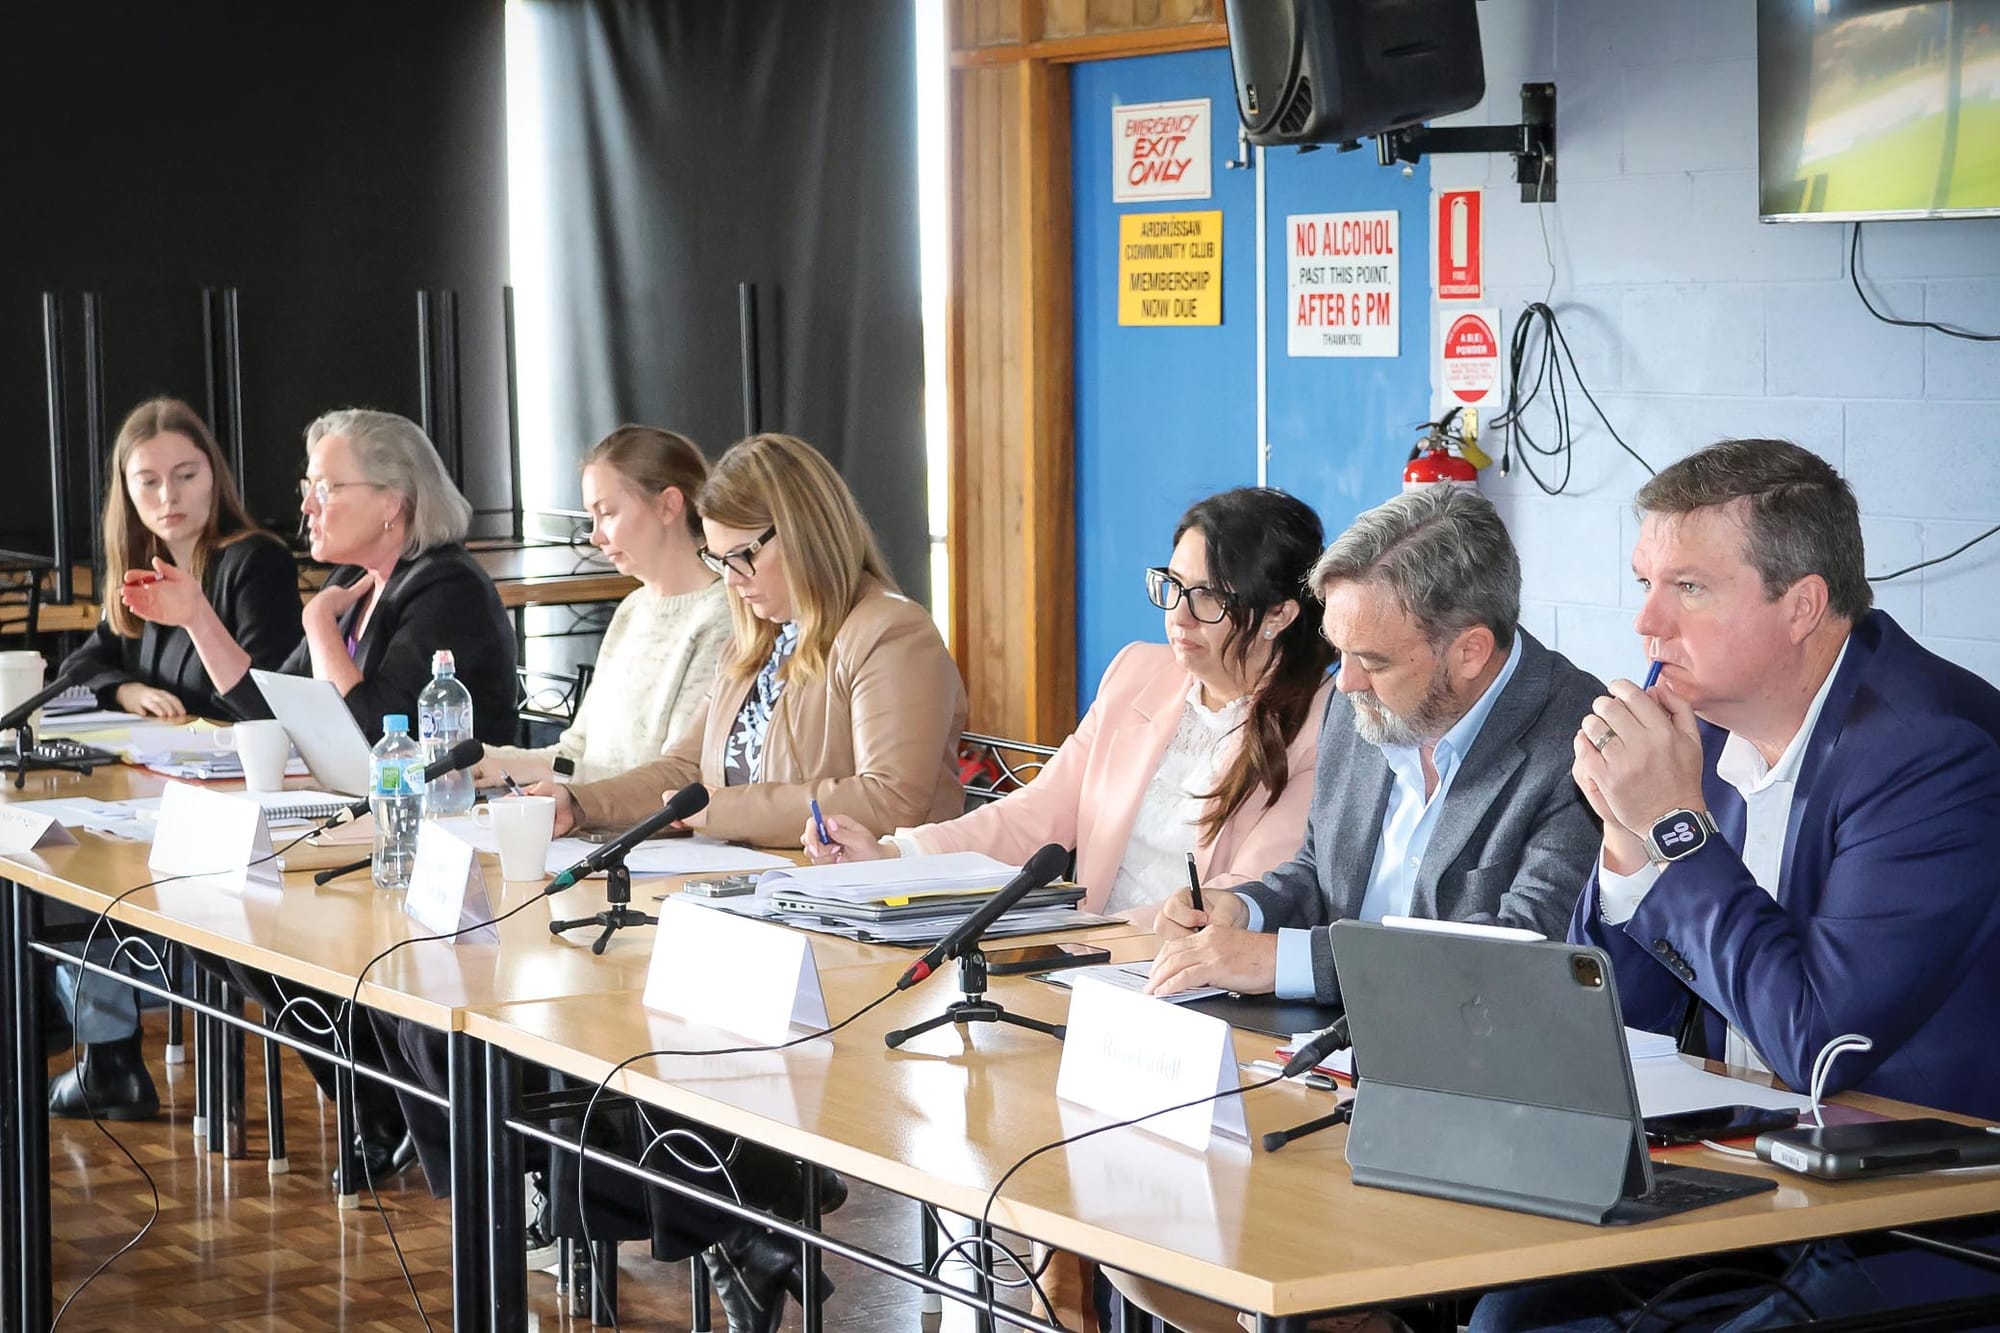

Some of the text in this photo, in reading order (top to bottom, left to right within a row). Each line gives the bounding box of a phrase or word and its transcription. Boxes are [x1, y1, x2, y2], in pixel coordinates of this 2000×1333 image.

[1125, 114, 1200, 137] EMERGENCY
[1133, 136, 1186, 159] EXIT
[1128, 157, 1192, 186] ONLY
[1296, 219, 1393, 256] NO ALCOHOL
[1125, 242, 1215, 260] COMMUNITY CLUB
[1129, 271, 1211, 292] MEMBERSHIP
[1299, 266, 1325, 285] PAST
[1329, 266, 1353, 284] THIS
[1141, 298, 1197, 318] NOW DUE
[1297, 292, 1390, 327] AFTER 6 PM
